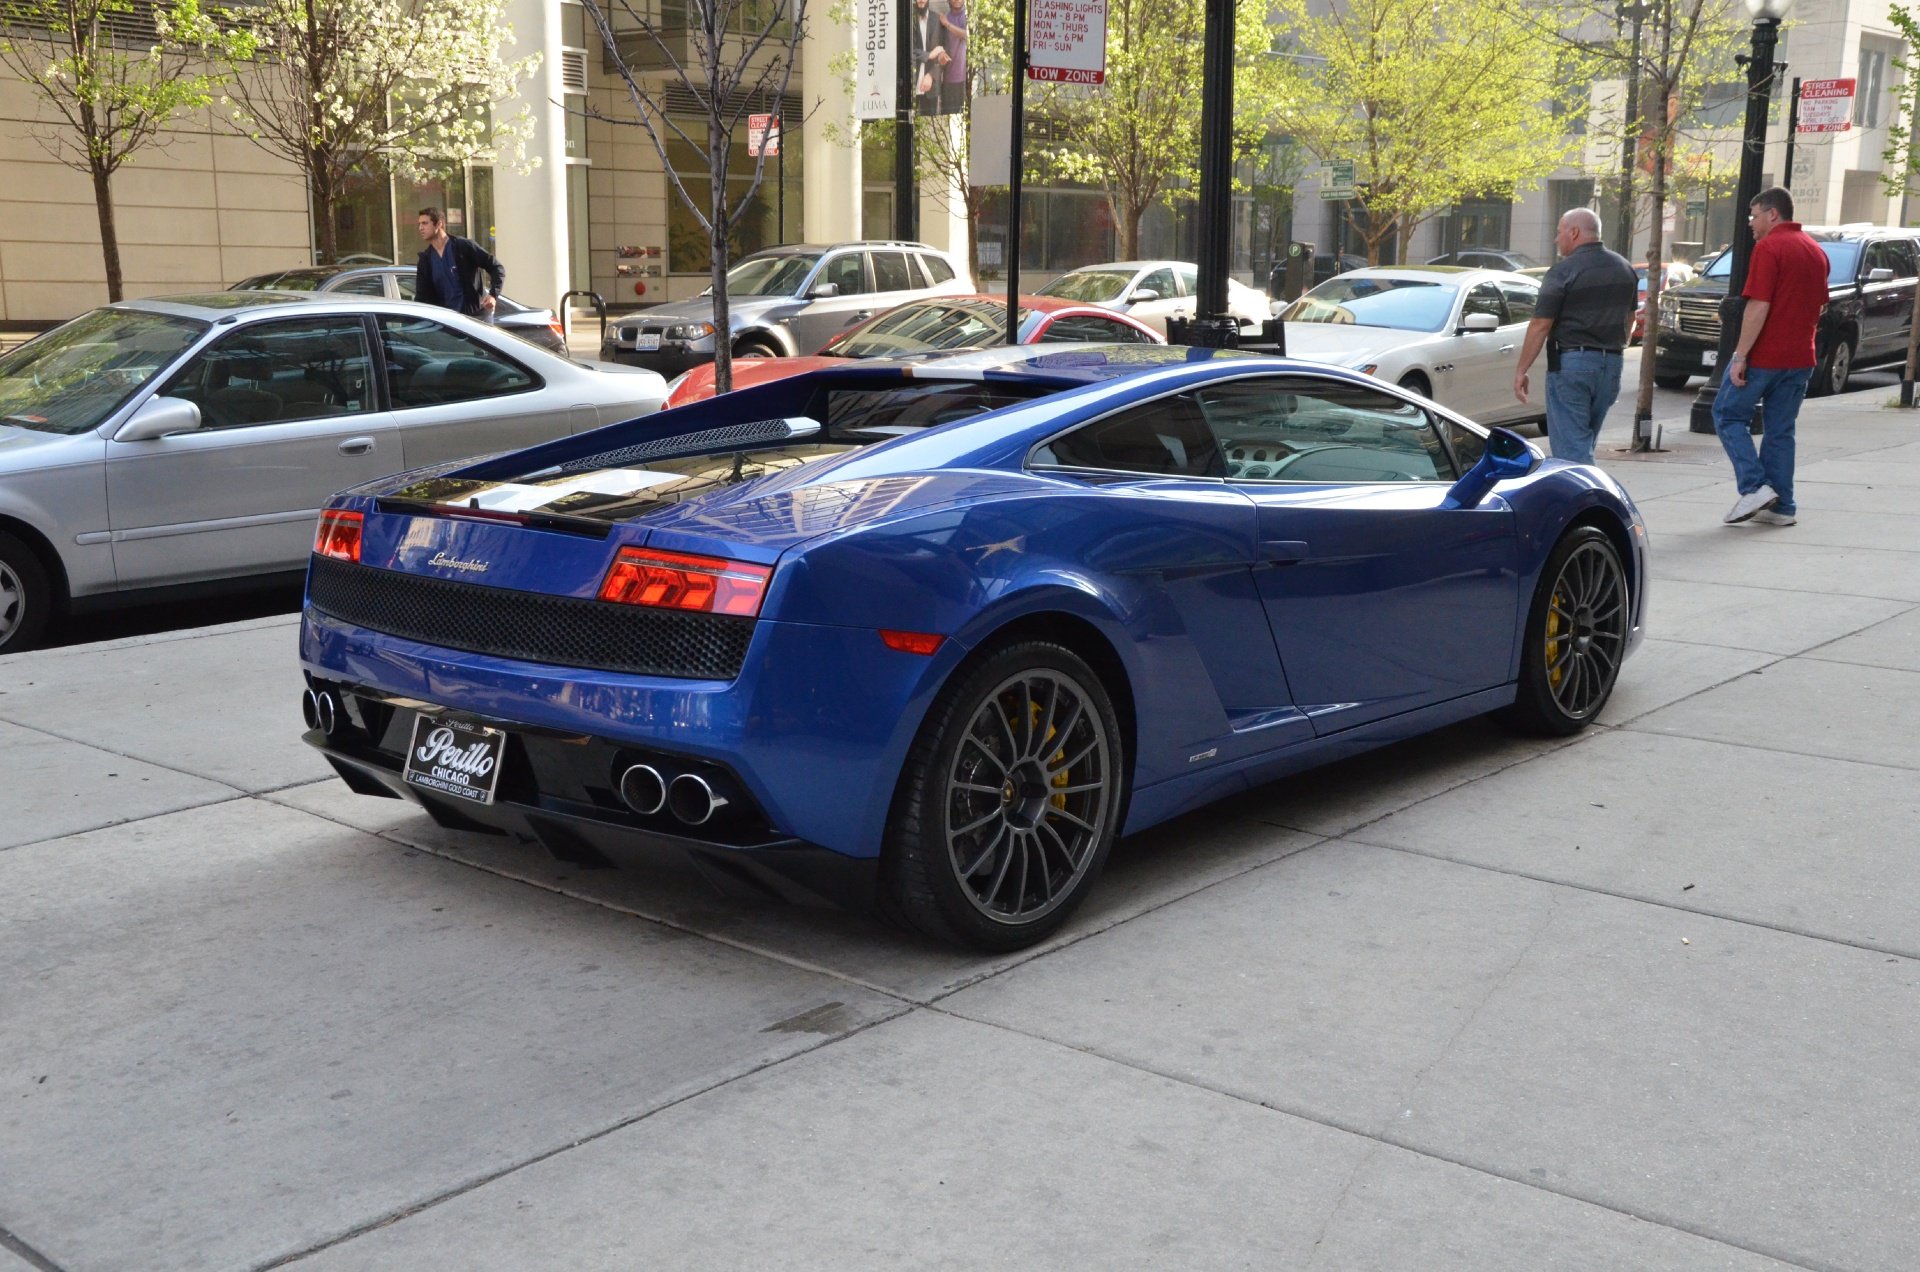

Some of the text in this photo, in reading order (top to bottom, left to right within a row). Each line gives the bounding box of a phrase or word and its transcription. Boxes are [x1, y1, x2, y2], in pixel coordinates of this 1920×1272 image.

[1034, 1, 1103, 14] FLASHING LIGHTS
[1065, 12, 1071, 21] 8
[1073, 13, 1085, 22] PM
[878, 0, 889, 50] ching
[1033, 20, 1052, 30] MON
[1061, 22, 1089, 33] THURS
[1064, 33, 1070, 41] 6
[1071, 33, 1084, 43] PM
[1033, 40, 1047, 50] FRI
[1054, 42, 1072, 52] SUN
[1032, 67, 1098, 84] TOW ZONE
[1806, 80, 1838, 90] STREET
[1804, 88, 1849, 98] CLEANING
[862, 100, 888, 111] LUMA
[1801, 123, 1846, 132] TOW ZONE
[1792, 188, 1821, 198] RBOY
[428, 551, 489, 573] Lamborghini
[446, 719, 475, 731] Perillo
[416, 727, 494, 778] Perillo
[431, 765, 470, 785] CHICAGO
[415, 774, 479, 798] LAMBORGHINI GOLD COAST
